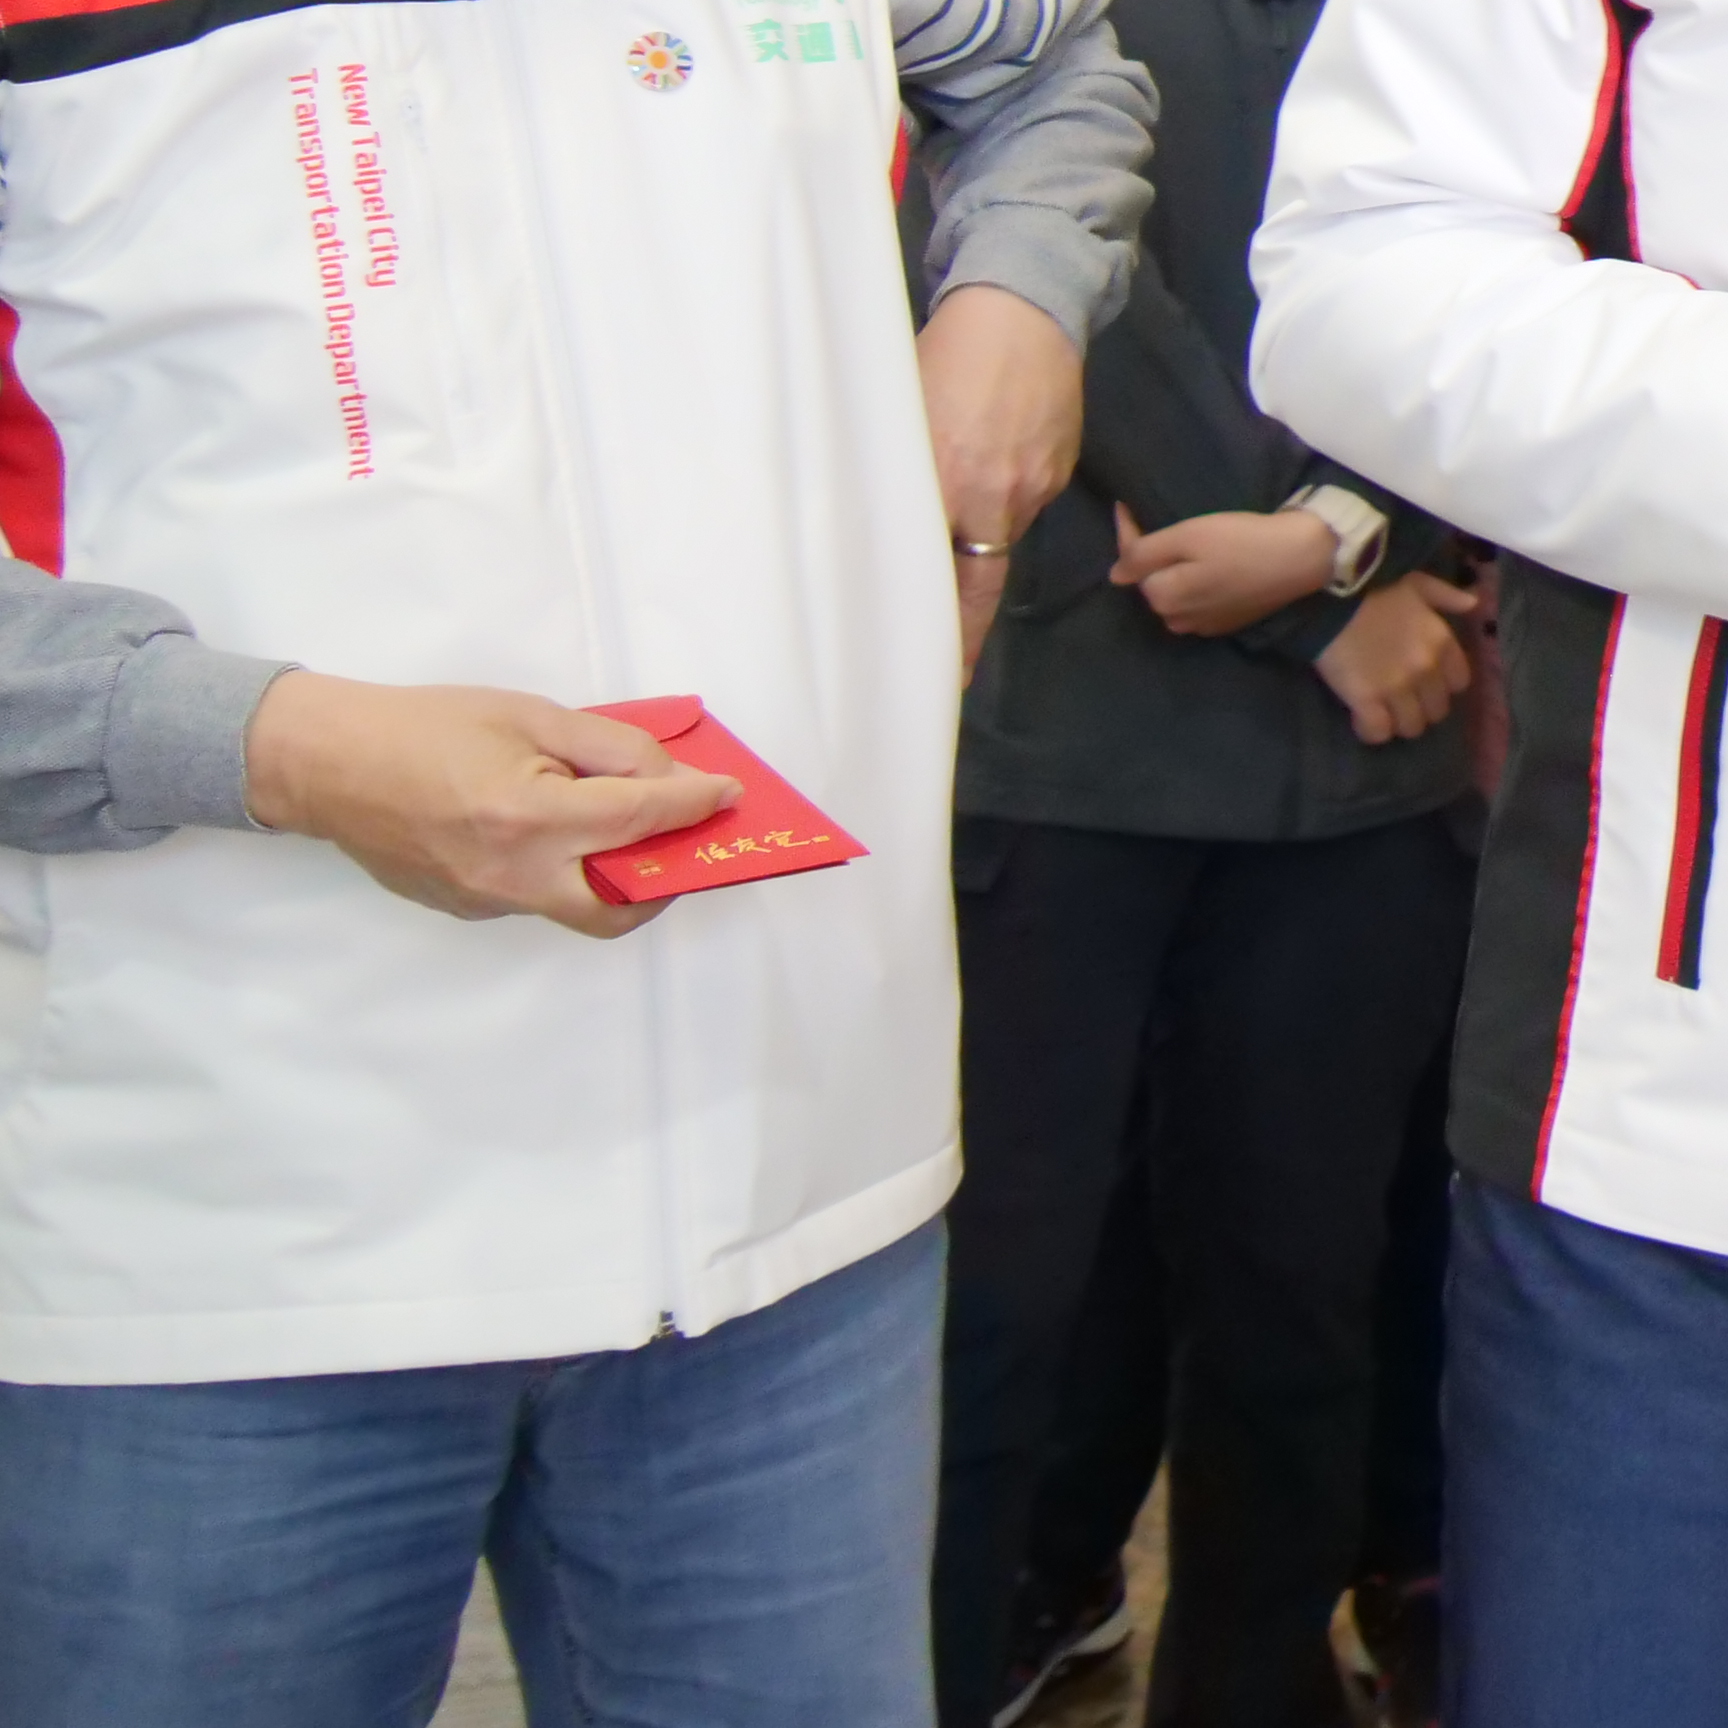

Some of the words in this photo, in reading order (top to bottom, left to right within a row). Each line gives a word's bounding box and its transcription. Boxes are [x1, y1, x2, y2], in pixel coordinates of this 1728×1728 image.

[743, 19, 864, 63] 交通
[337, 62, 371, 126] New
[351, 132, 396, 223] Taipei
[287, 67, 349, 300] Transportation
[323, 303, 375, 481] Department
[363, 226, 401, 289] City
